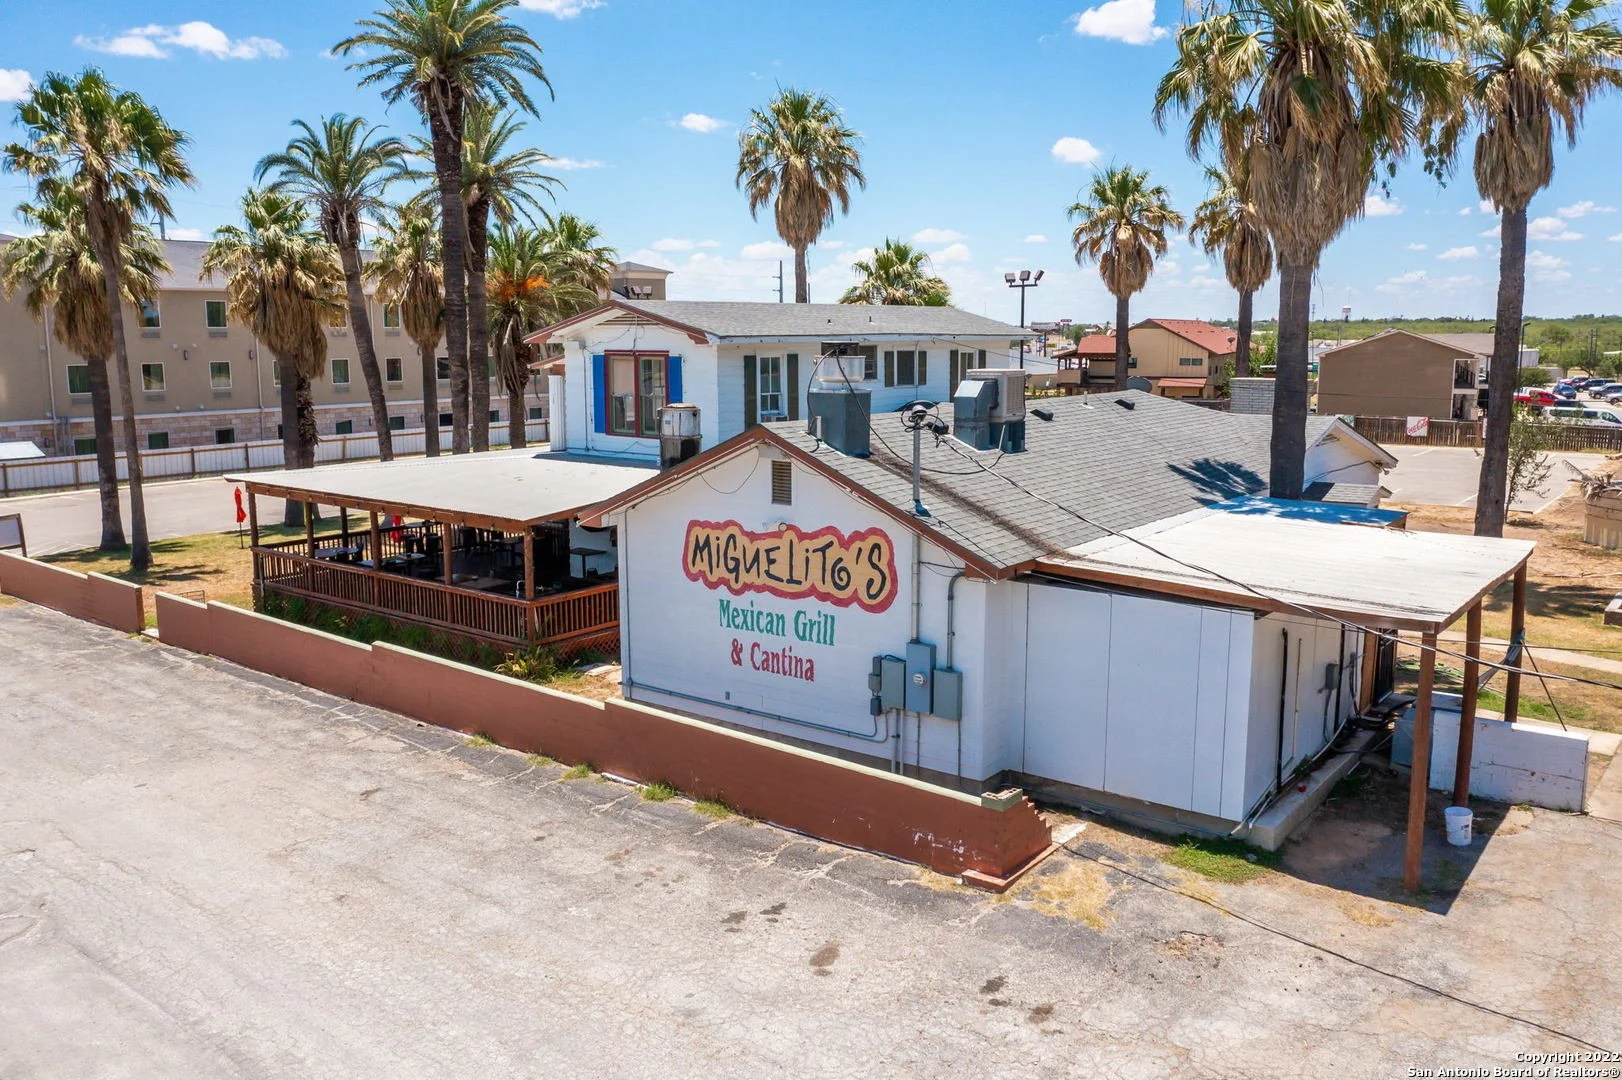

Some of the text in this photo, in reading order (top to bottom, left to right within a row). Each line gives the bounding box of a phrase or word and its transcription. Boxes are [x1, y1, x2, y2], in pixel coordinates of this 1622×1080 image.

[719, 598, 835, 646] Mexican Grill
[731, 638, 814, 681] & Cantina
